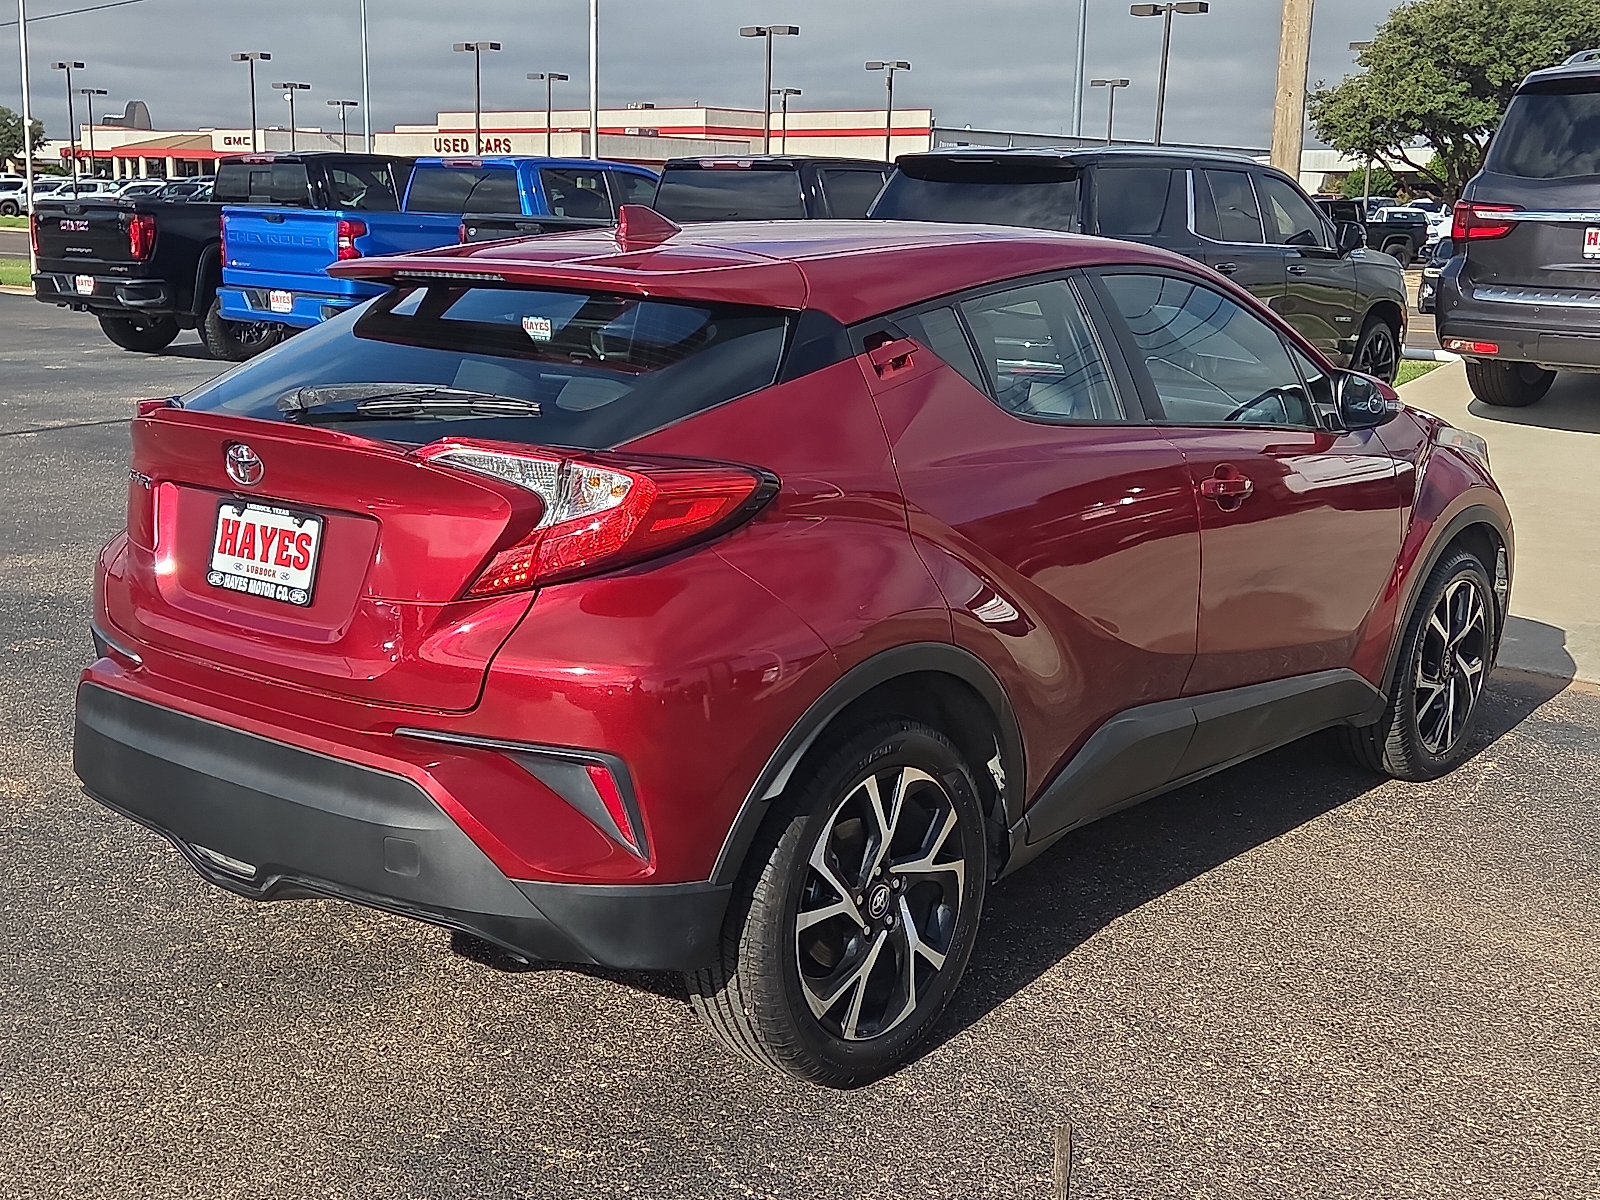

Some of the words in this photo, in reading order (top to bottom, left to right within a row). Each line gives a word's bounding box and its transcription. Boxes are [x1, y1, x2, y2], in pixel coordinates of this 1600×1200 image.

[223, 136, 251, 146] GMC
[433, 137, 470, 153] USED
[479, 137, 512, 154] CARS
[227, 229, 327, 247] CHEVROLET
[523, 320, 550, 332] HAYES
[217, 517, 313, 571] HAYES
[245, 564, 277, 579] LUBBOCK
[223, 573, 249, 592] HAYES
[247, 579, 277, 599] MOTOR
